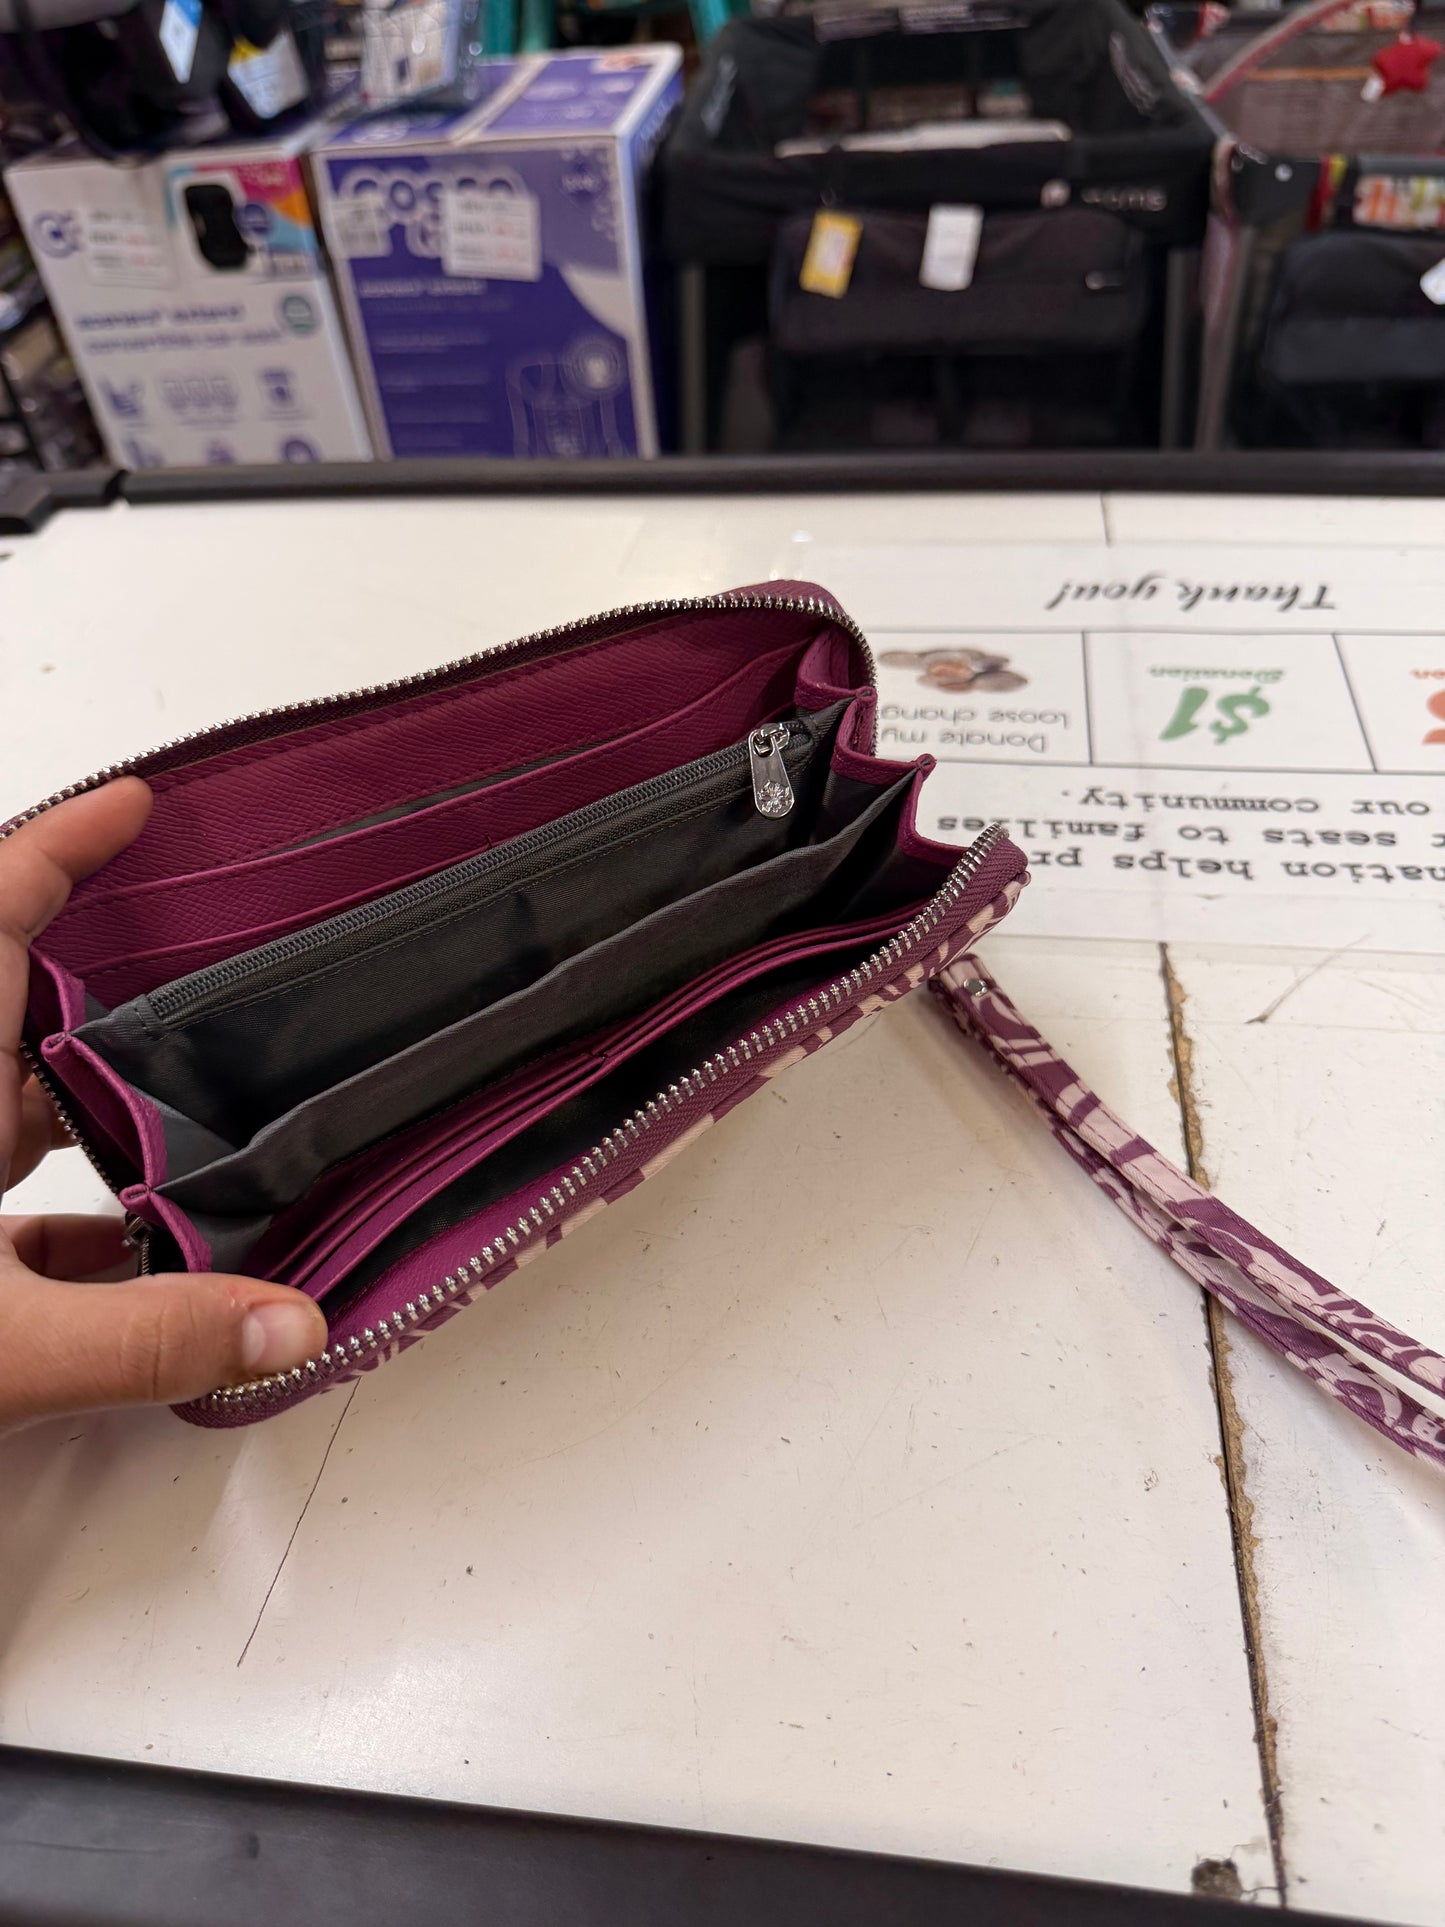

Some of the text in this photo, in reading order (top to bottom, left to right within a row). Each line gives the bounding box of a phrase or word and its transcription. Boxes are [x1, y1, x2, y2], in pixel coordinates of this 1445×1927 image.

[1043, 572, 1337, 613] Thank you!
[879, 703, 1070, 730] loose chang
[1158, 685, 1272, 746] $1
[880, 726, 1048, 754] Donate my
[1060, 786, 1432, 817] our community.
[1177, 824, 1231, 846] to
[1261, 826, 1399, 848] seats
[1112, 847, 1256, 881] helps
